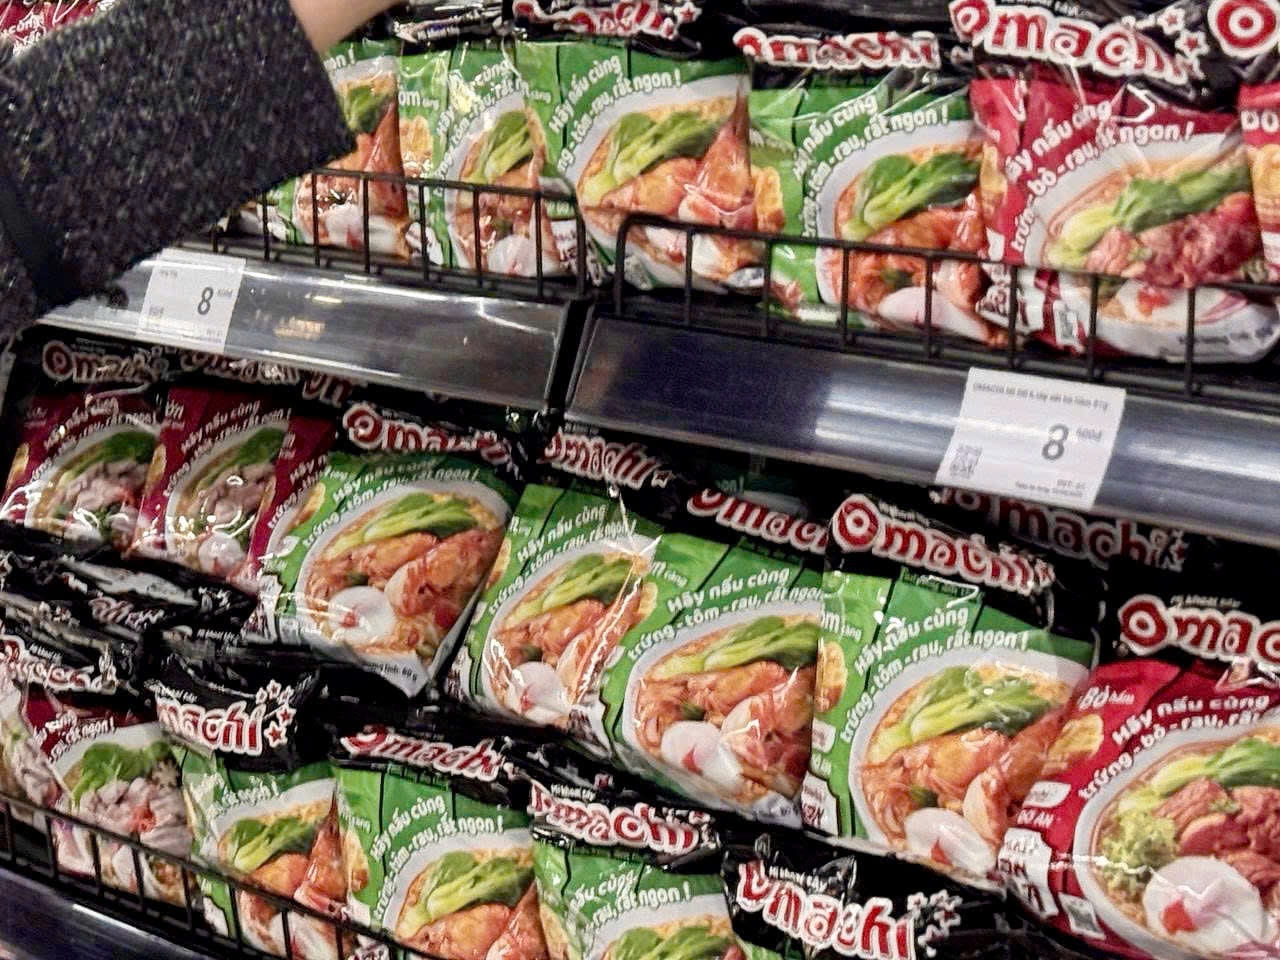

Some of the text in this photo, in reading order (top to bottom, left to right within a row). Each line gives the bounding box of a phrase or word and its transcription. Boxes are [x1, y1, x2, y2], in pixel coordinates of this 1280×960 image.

[197, 286, 214, 316] 8
[1041, 422, 1070, 462] 8
[687, 488, 830, 554] Omac
[666, 566, 791, 615] Hãy nấu cùng
[625, 624, 677, 663] trứng
[684, 605, 721, 626] tôm
[729, 592, 763, 613] rau,
[922, 606, 970, 637] cùng
[1118, 594, 1280, 676] Omac
[839, 693, 876, 745] trứng
[873, 656, 905, 692] tôm
[911, 642, 944, 667] rau,
[1111, 693, 1270, 745] Hãy nấu cùng
[156, 700, 266, 756] machi
[1078, 753, 1135, 800] trứng
[1139, 724, 1167, 748] bò
[1179, 713, 1224, 731] rau,
